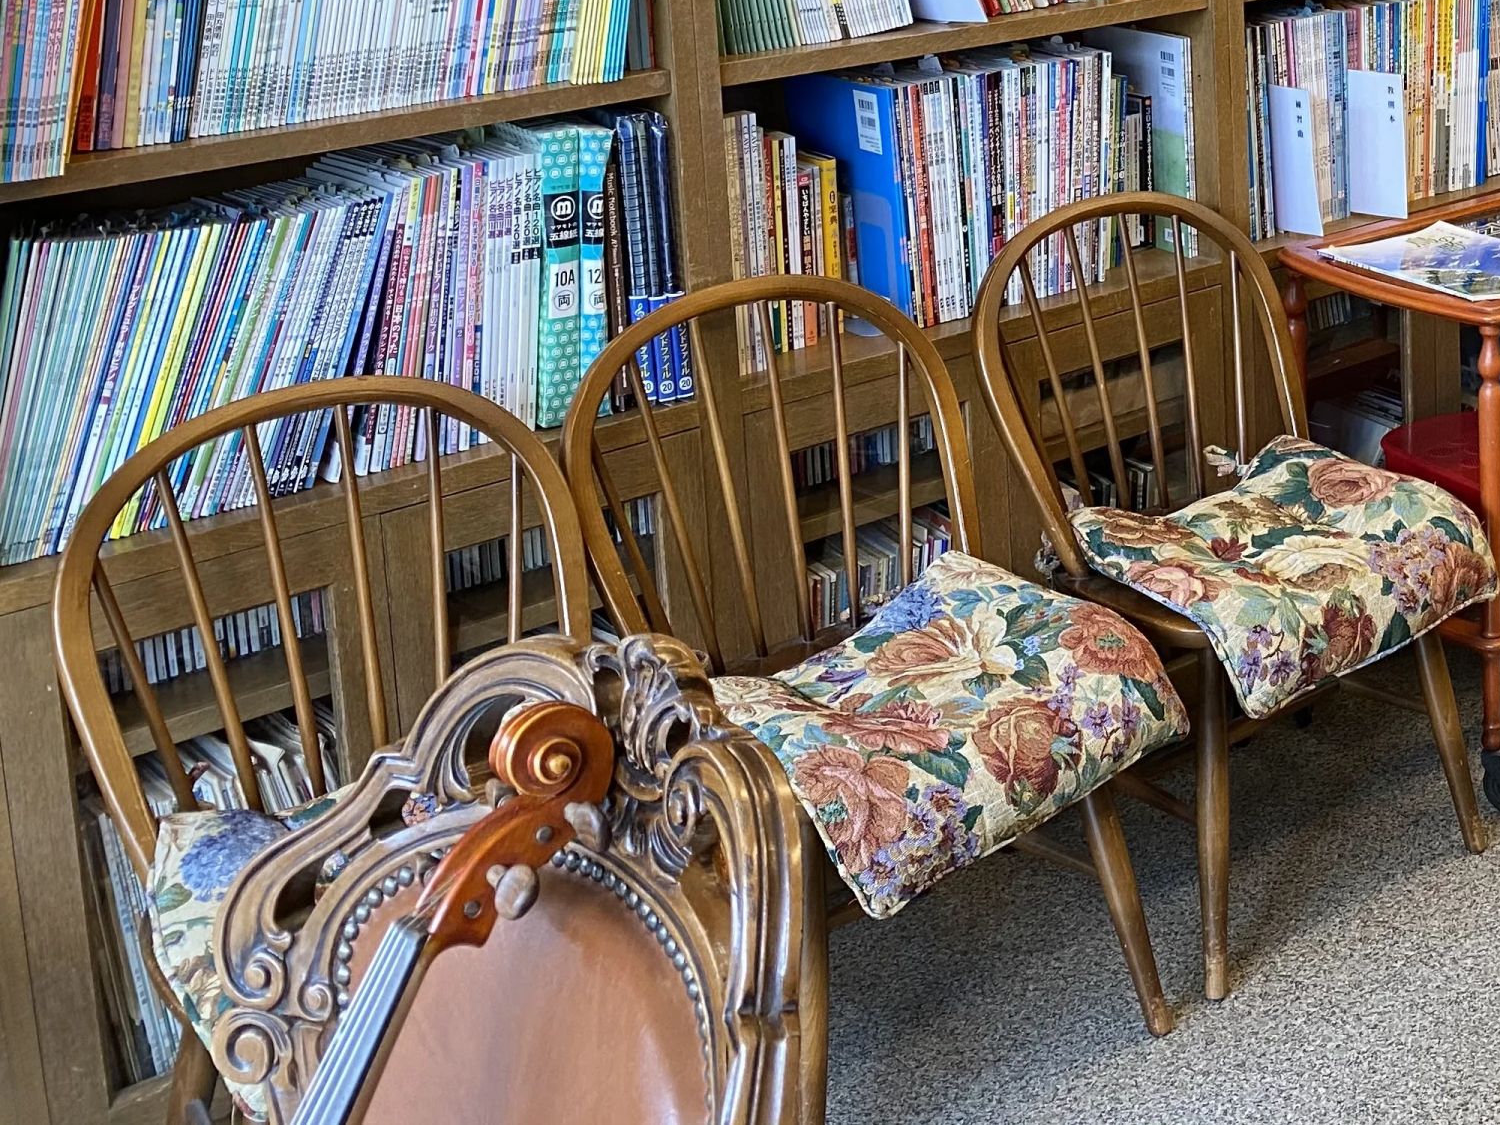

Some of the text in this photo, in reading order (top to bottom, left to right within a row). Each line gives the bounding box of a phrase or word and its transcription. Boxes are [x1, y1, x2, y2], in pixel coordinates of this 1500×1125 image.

[511, 171, 522, 250] ピアノ名曲120選
[523, 168, 533, 246] ピアノ名曲120選
[531, 168, 541, 245] ピアノ名曲120選
[607, 172, 618, 238] Music Notebook
[801, 189, 811, 236] いちばんやさしい
[549, 228, 578, 242] 五線紙
[555, 269, 576, 287] 10A
[389, 305, 403, 353] 日本のうた
[661, 381, 673, 392] 20
[680, 378, 692, 388] 20
